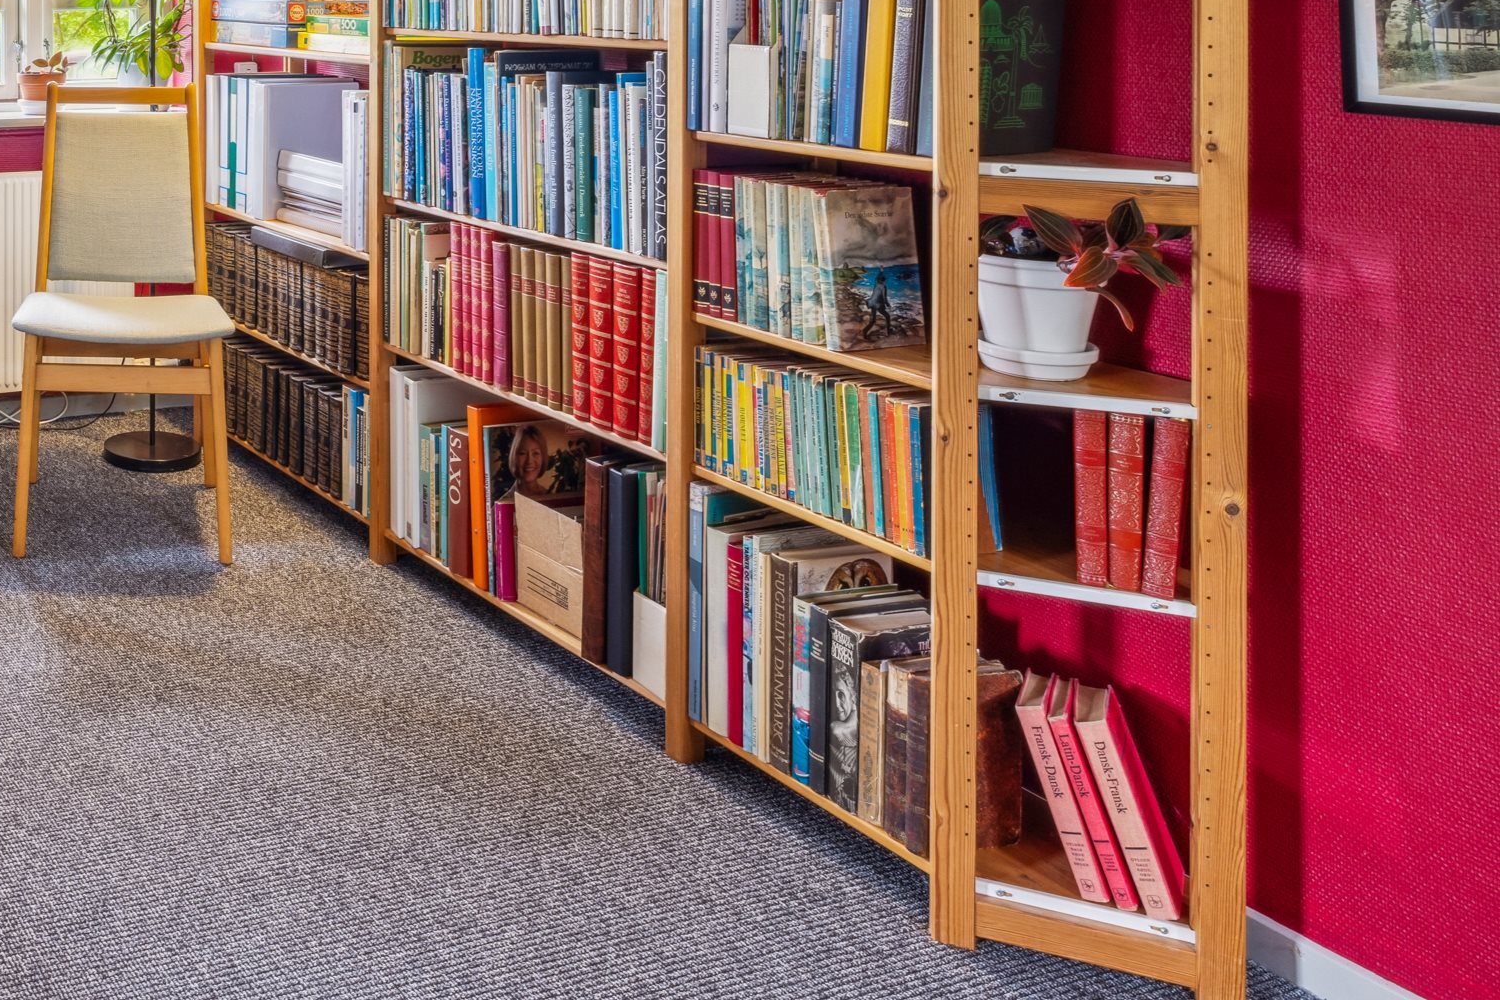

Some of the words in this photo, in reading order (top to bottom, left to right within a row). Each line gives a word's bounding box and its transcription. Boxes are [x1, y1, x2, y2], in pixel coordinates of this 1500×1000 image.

[549, 114, 557, 128] Stig
[549, 129, 556, 138] og
[551, 139, 557, 148] de
[654, 69, 666, 185] GYLDENDALS
[549, 177, 556, 187] på
[654, 187, 666, 245] ATLAS
[449, 434, 462, 505] SAXO
[744, 571, 750, 582] OG
[774, 569, 785, 646] FUGLELIV
[831, 641, 854, 657] KAREN
[831, 647, 854, 668] BLIXEN
[773, 655, 785, 742] DANMARK
[1031, 725, 1066, 799] Fransk-Dansk
[1058, 733, 1091, 798] Latin-Dansk
[1093, 740, 1129, 815] Dansk-Fransk
